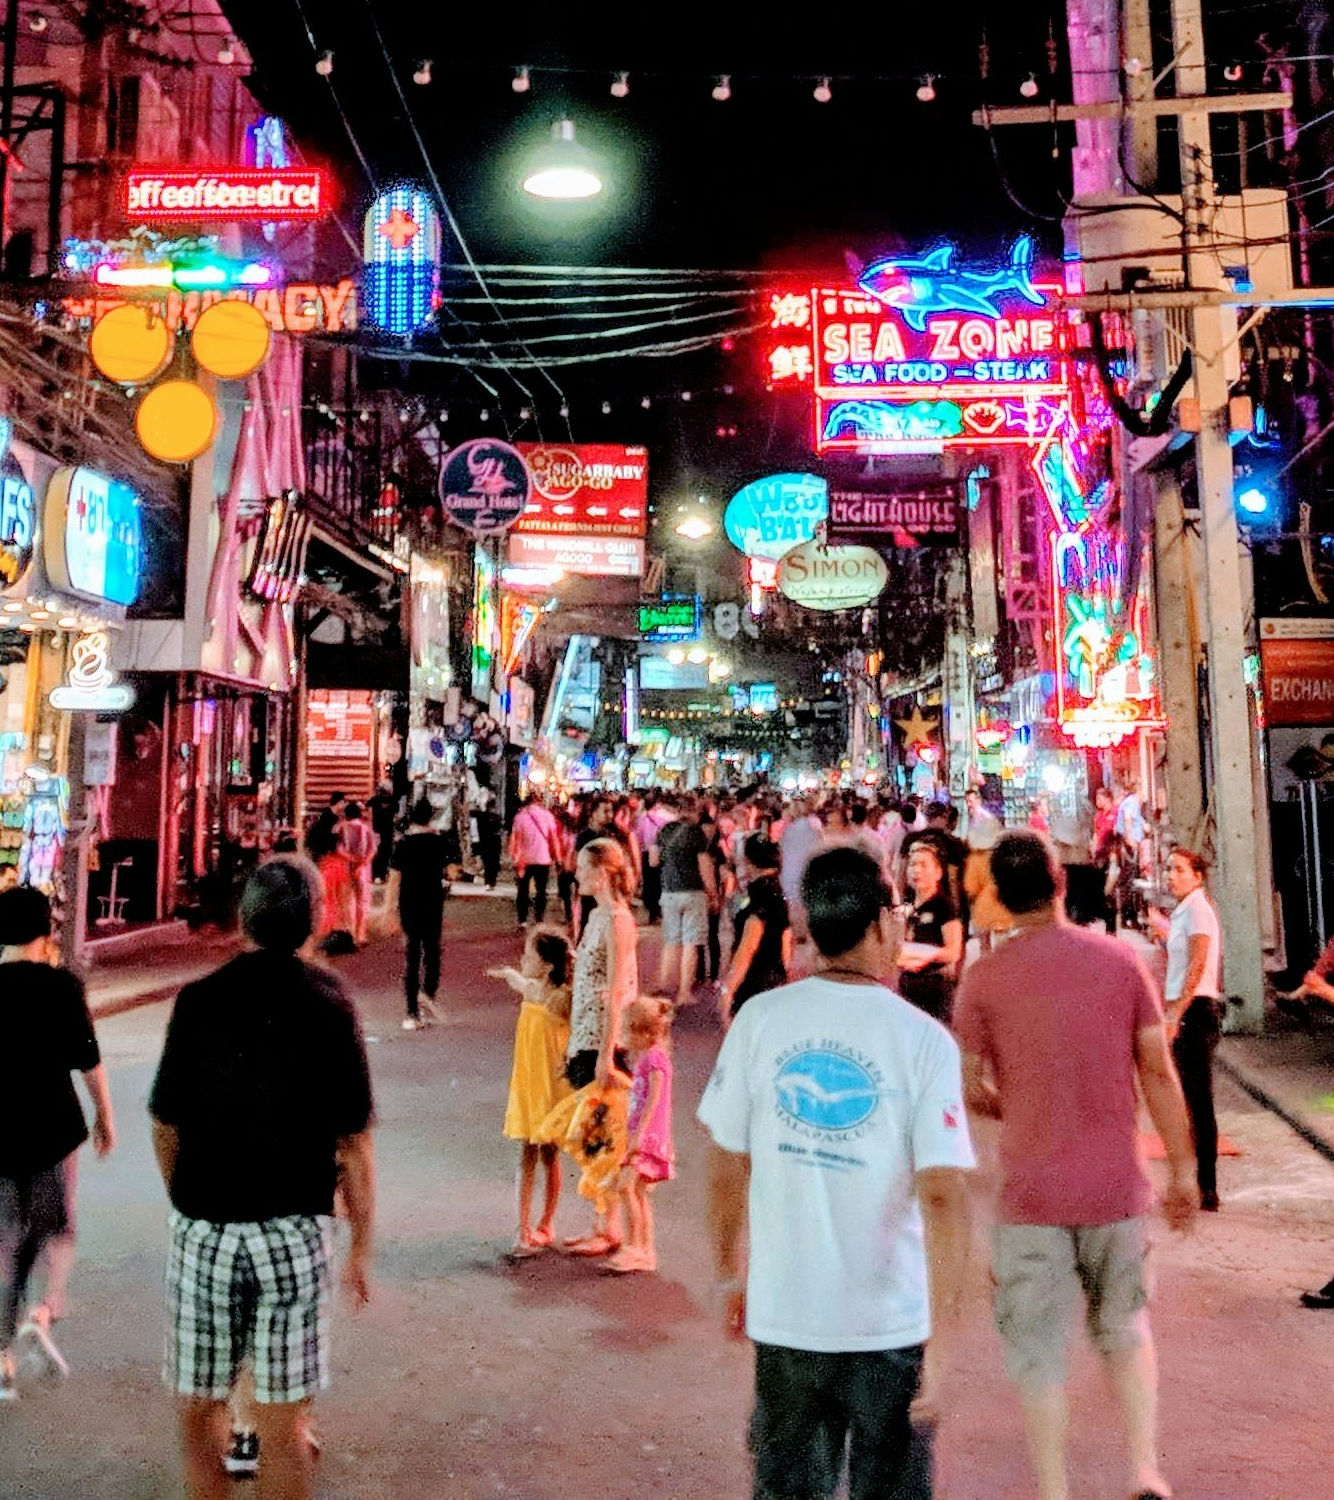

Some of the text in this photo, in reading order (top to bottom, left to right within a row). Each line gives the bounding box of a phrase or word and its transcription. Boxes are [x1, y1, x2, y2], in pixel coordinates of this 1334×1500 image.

[823, 319, 1055, 363] SEA ZONE
[833, 363, 878, 384] SEA
[884, 362, 948, 383] FOOD
[446, 493, 486, 508] Grand
[831, 499, 957, 524] LIGHTHOUSE
[786, 553, 879, 583] SIMON
